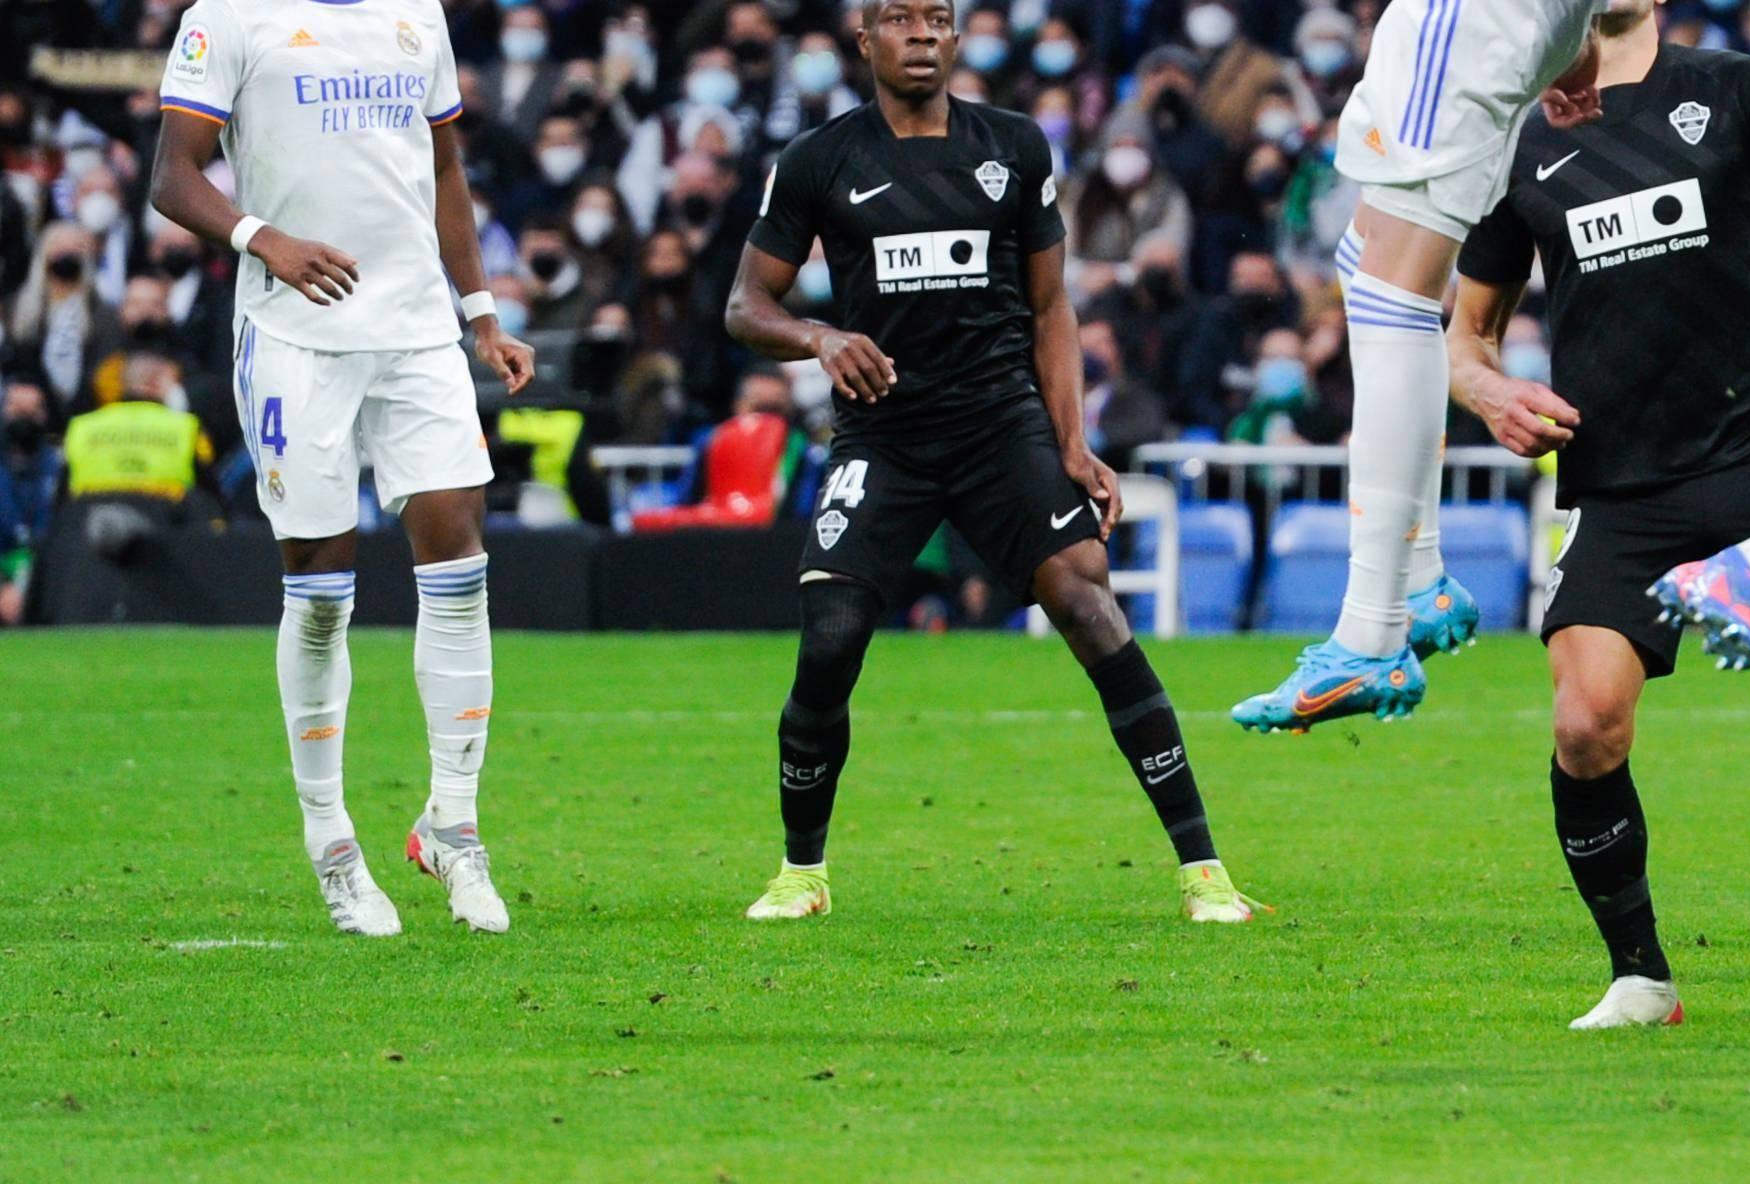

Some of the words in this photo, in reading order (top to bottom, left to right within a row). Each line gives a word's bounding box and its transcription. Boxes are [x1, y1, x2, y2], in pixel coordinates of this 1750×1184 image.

[293, 68, 427, 106] Emirates
[322, 107, 350, 133] FLY
[358, 103, 415, 130] BETTER
[1578, 212, 1623, 244] TM
[883, 246, 922, 269] TM
[1578, 258, 1599, 274] TM
[1599, 250, 1627, 269] Real
[1627, 241, 1668, 261] Estate
[1668, 234, 1710, 252] Group
[877, 281, 897, 294] TM
[897, 278, 923, 292] Real
[923, 276, 958, 291] Estate
[959, 275, 990, 289] Group
[261, 397, 287, 457] 4
[820, 459, 869, 510] 14
[782, 760, 828, 781] ECF
[1142, 745, 1183, 771] ECF
